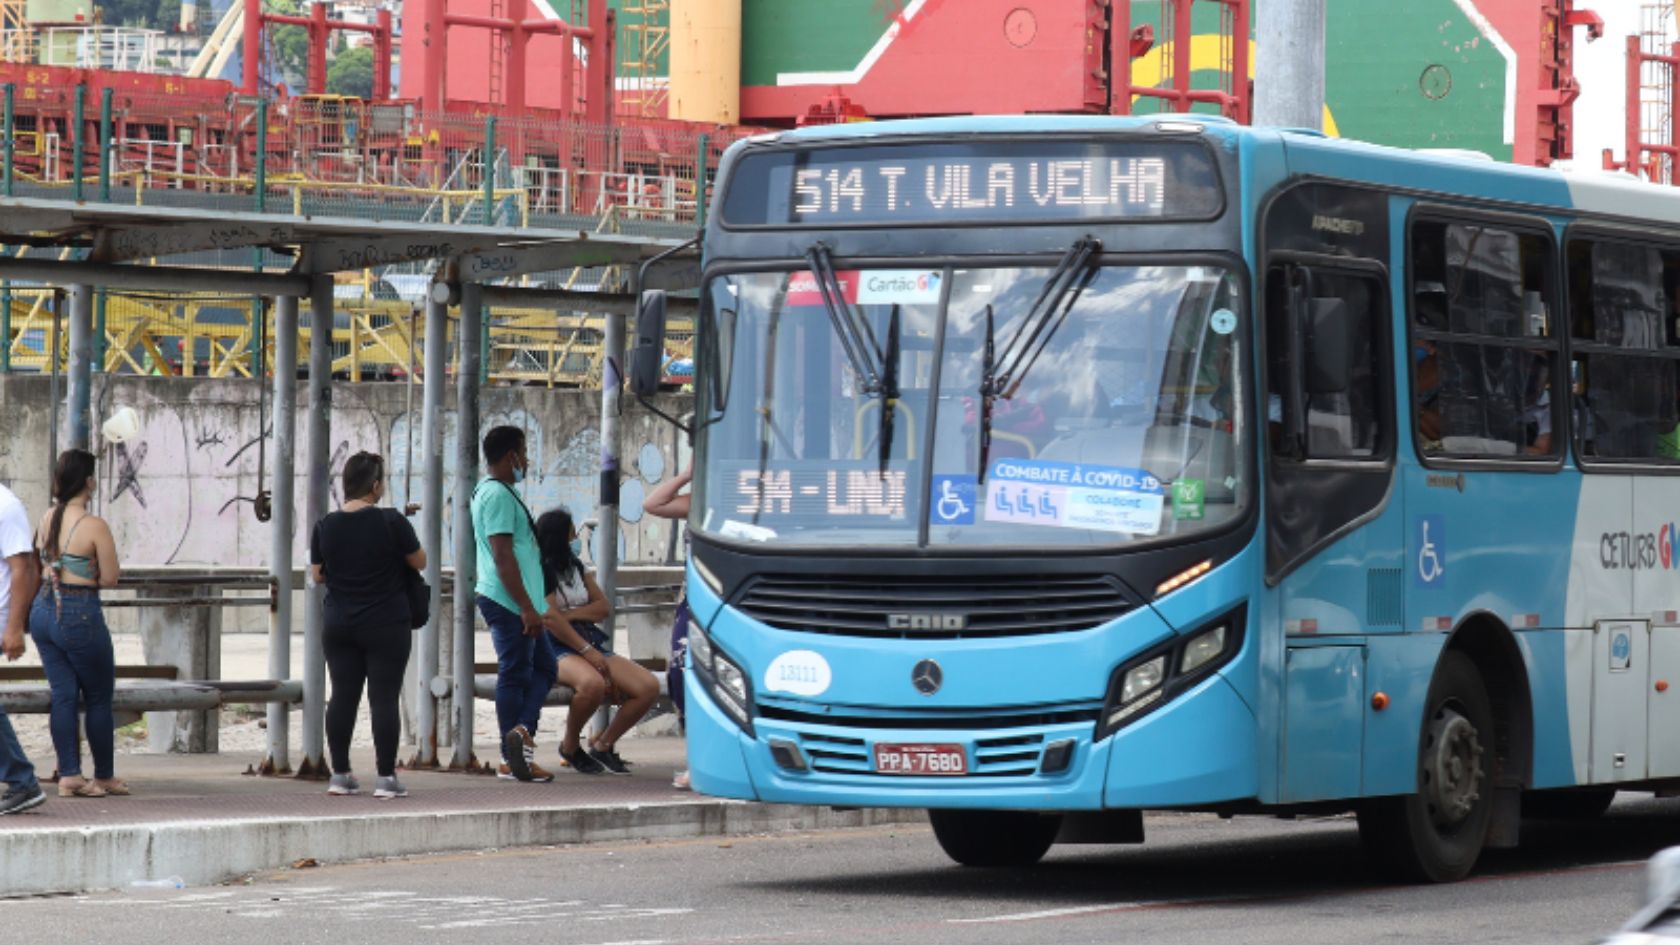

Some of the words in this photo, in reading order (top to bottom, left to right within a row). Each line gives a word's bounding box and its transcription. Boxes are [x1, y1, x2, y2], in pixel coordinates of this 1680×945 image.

[796, 168, 864, 212] 514
[880, 166, 911, 210] T.
[926, 163, 1014, 208] VILA
[1029, 158, 1165, 207] VELHA
[994, 463, 1070, 484] COMBATE
[1084, 470, 1159, 491] COVID-19
[1600, 531, 1657, 570] CETURB
[887, 613, 963, 629] CAIO
